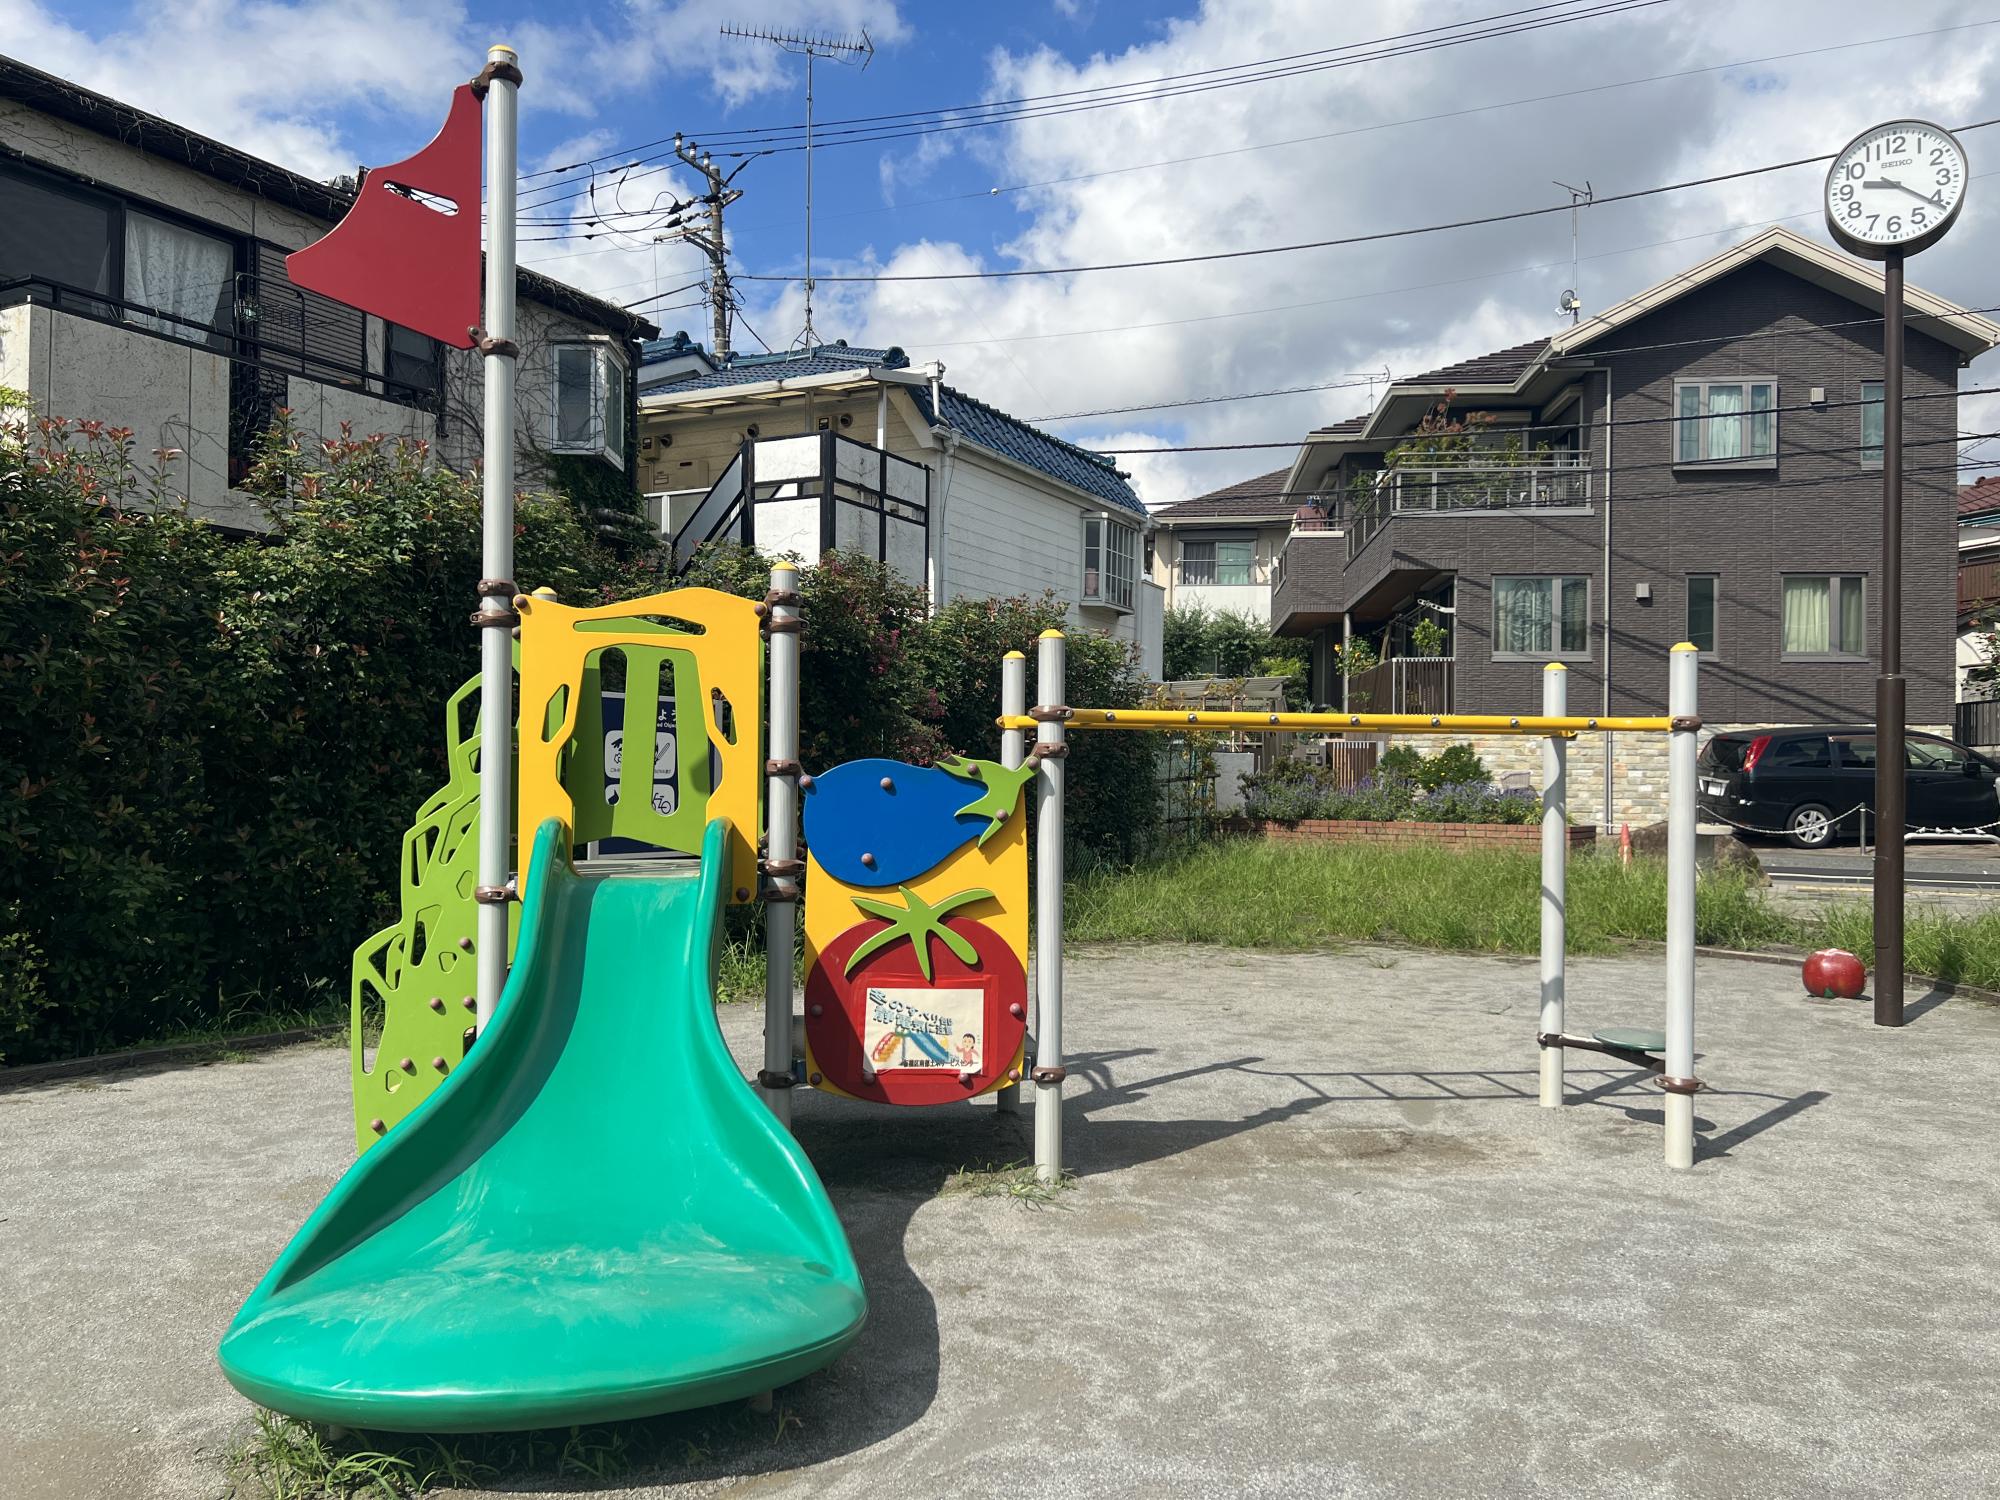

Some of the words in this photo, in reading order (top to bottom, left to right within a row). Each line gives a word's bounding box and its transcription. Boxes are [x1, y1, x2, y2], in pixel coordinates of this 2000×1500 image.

[1866, 144, 1880, 162] 11
[1886, 135, 1906, 155] 12
[1917, 137, 1922, 154] 1
[1880, 158, 1913, 169] SEIKO
[1929, 148, 1944, 167] 2
[1845, 162, 1865, 181] 10
[1935, 168, 1951, 186] 3
[1839, 184, 1854, 202] 9
[1928, 188, 1944, 207] 4
[1847, 201, 1862, 219] 8
[1910, 206, 1926, 225] 5
[1865, 214, 1881, 232] 7
[1886, 215, 1902, 233] 6
